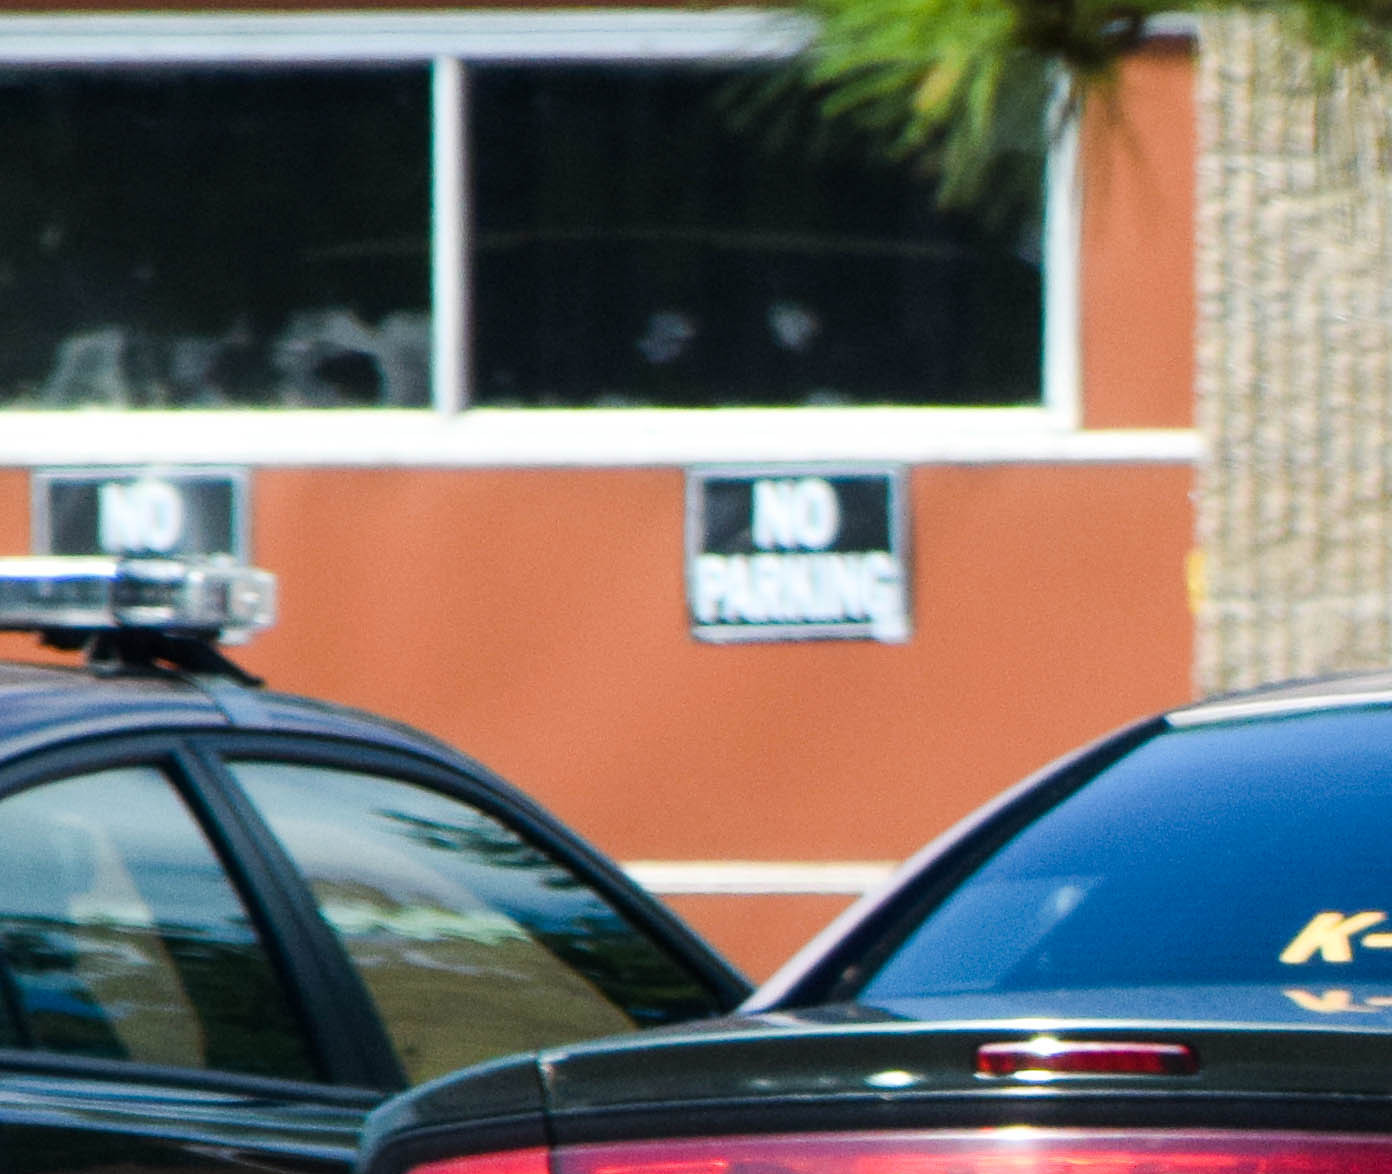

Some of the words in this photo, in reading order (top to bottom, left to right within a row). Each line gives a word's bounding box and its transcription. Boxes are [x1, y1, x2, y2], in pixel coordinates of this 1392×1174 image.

[100, 480, 181, 551] NO
[754, 477, 840, 551] NO
[693, 551, 903, 625] PARKING
